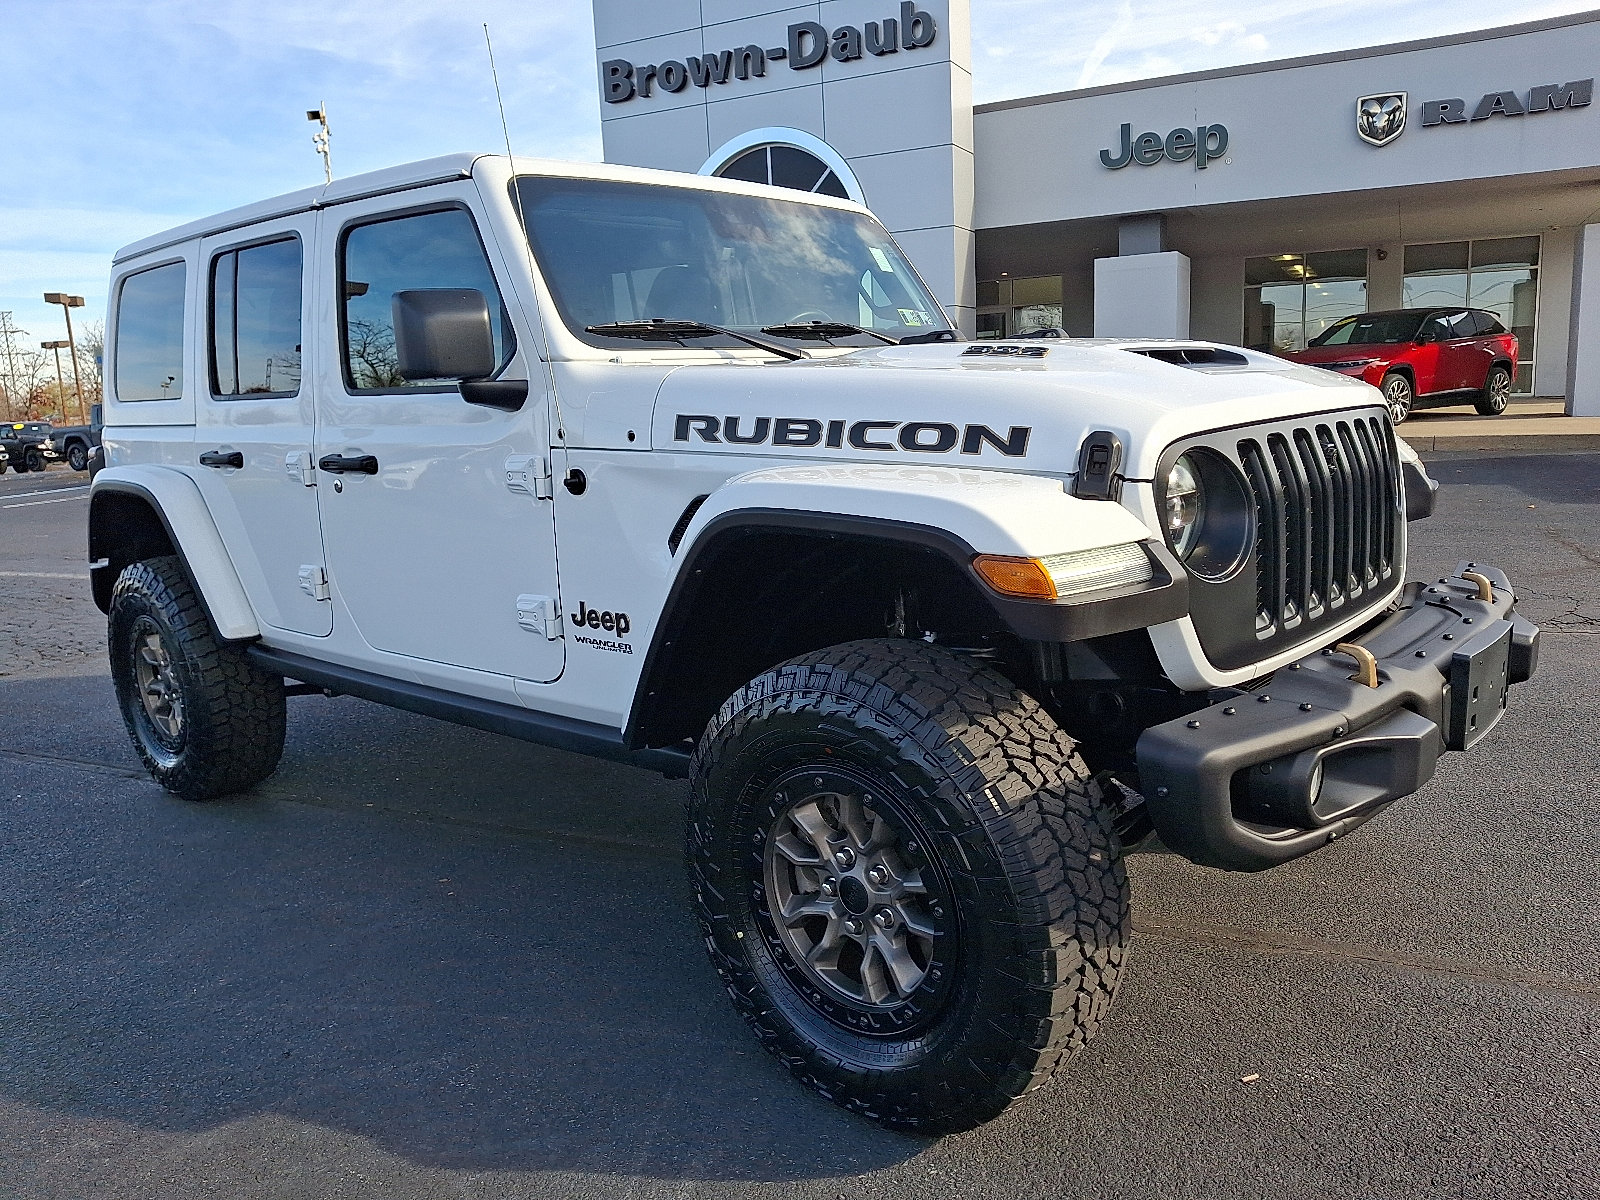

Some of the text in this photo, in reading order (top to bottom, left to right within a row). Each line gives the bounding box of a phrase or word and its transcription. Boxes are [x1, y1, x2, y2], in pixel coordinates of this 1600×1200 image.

[602, 1, 937, 104] Brown-Daub
[1421, 78, 1595, 126] RAM
[1099, 122, 1229, 169] Jeep
[673, 413, 1033, 458] RUBICON
[571, 600, 631, 638] Jeep
[574, 635, 632, 650] WRANGLER
[592, 644, 633, 654] UNLIMITED
